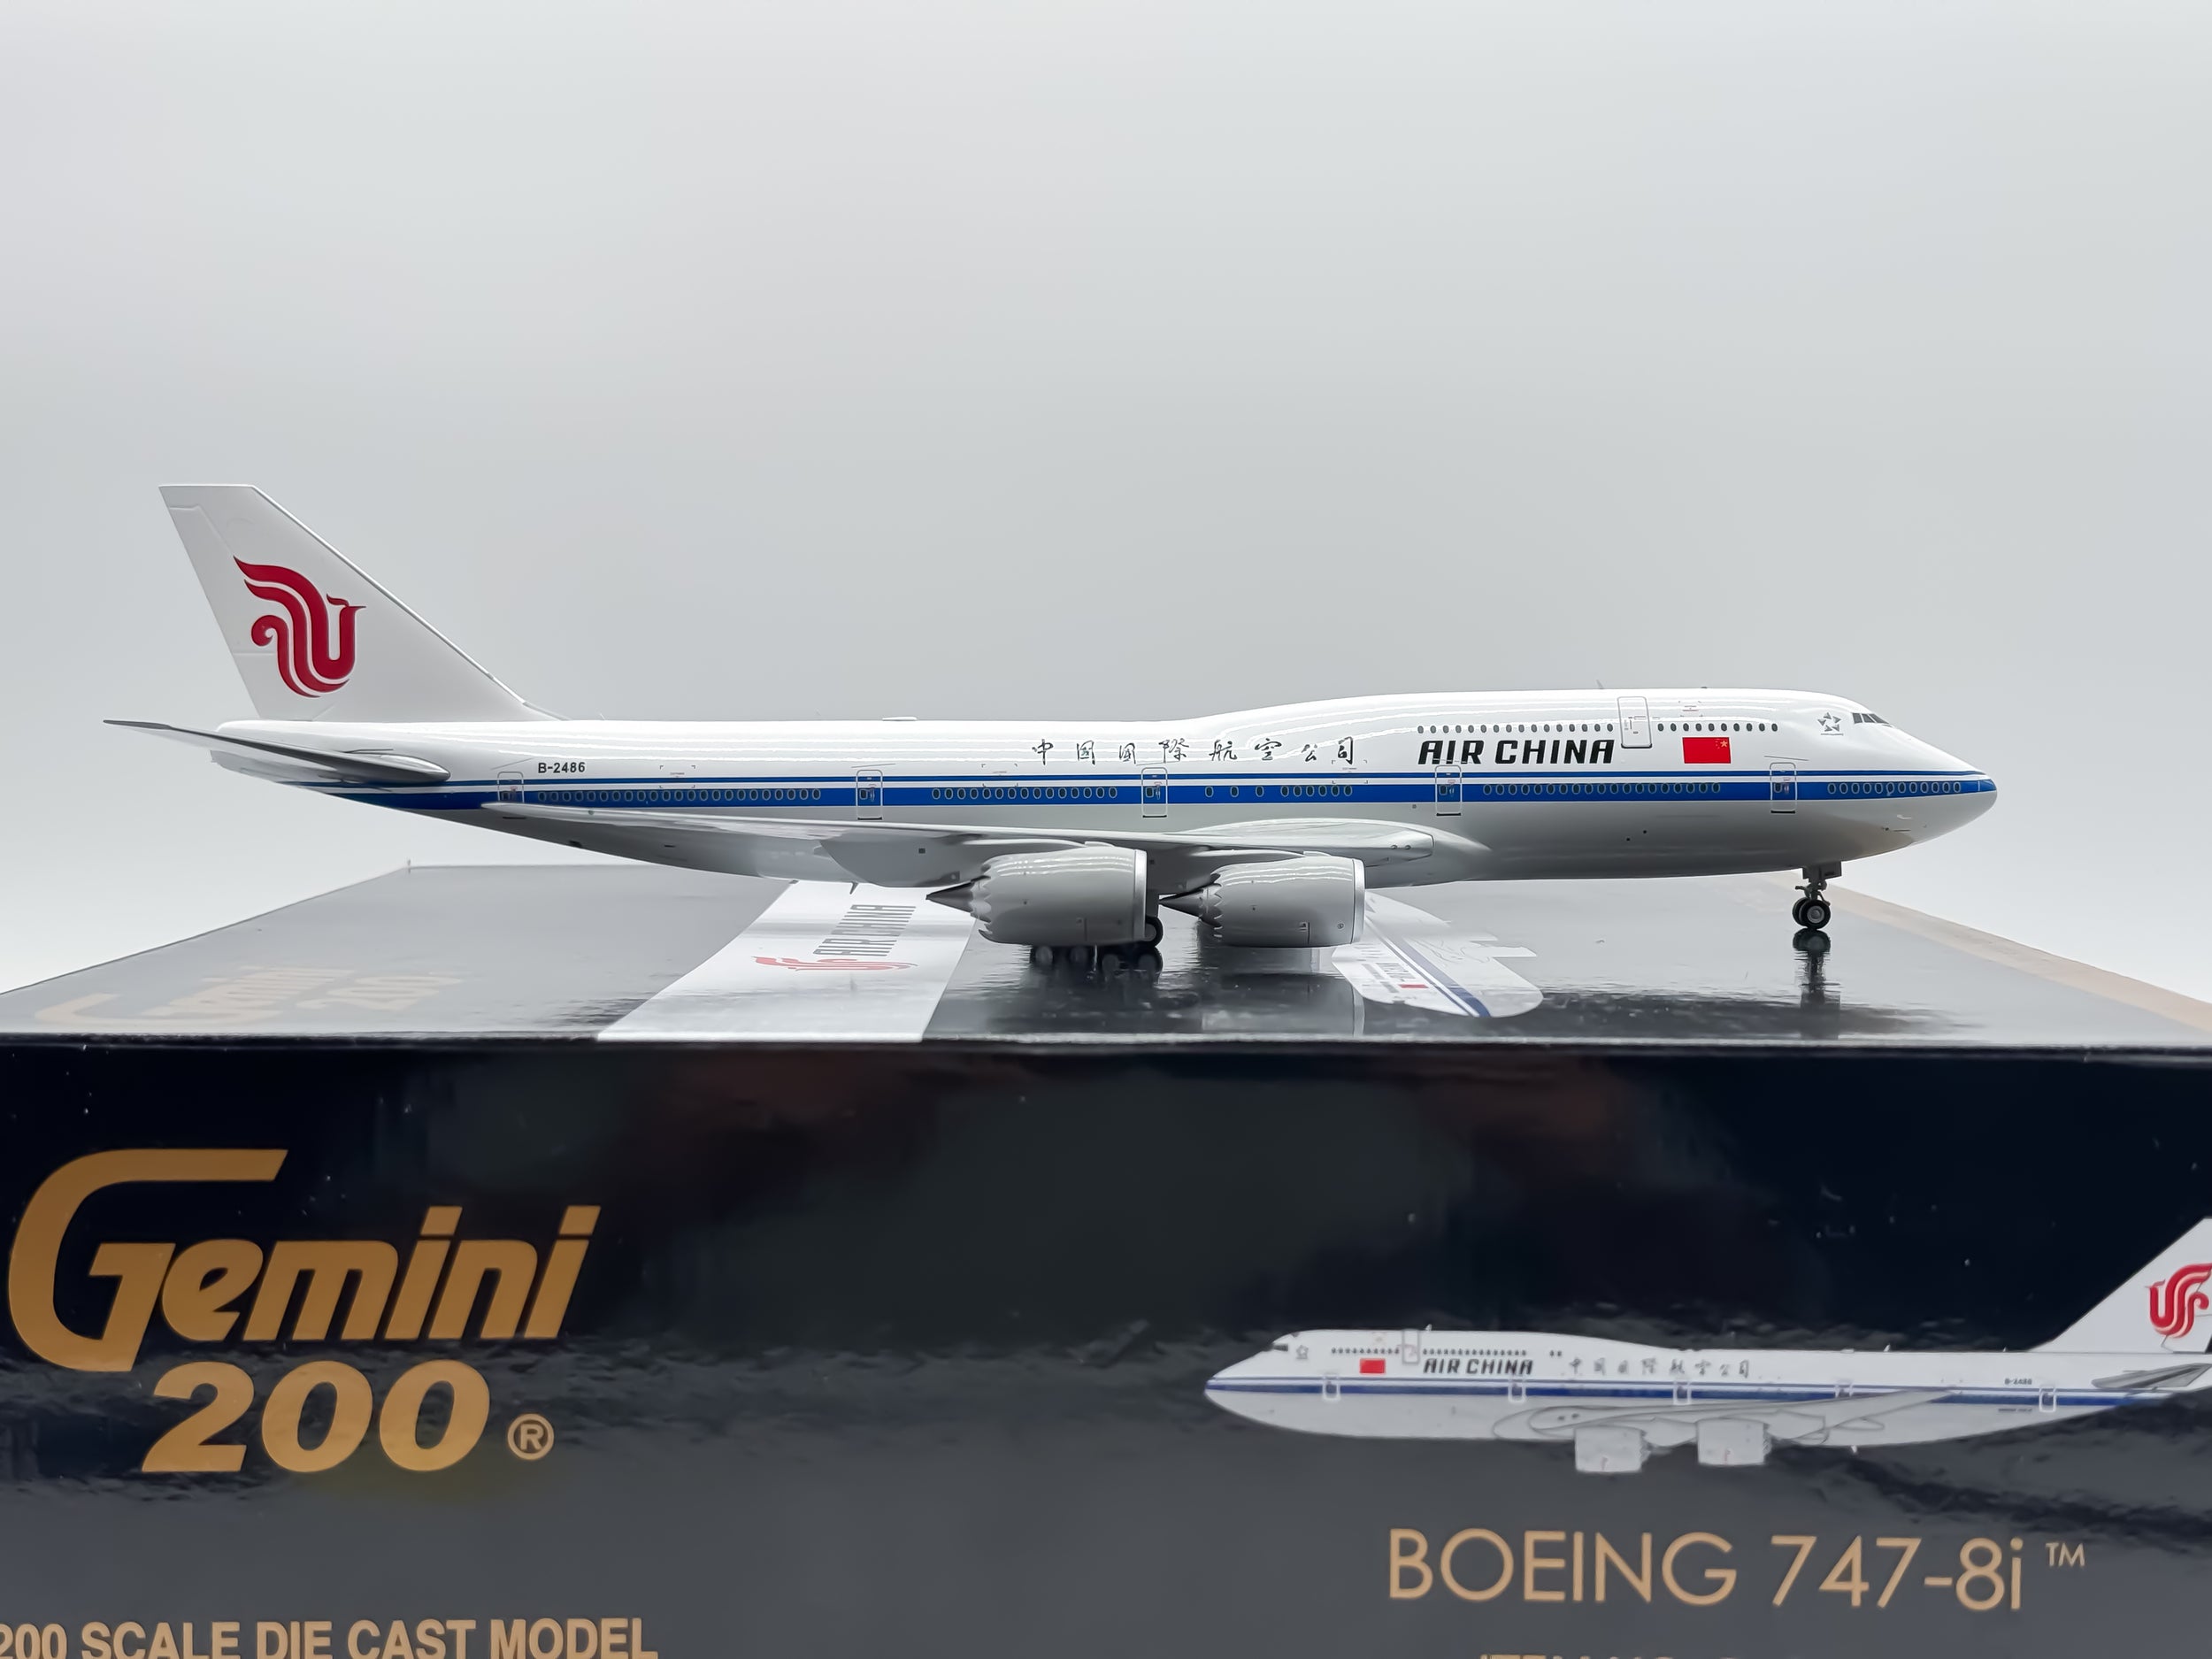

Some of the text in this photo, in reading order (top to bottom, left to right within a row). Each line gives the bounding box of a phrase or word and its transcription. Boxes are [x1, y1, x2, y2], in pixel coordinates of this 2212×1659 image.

[537, 761, 586, 774] B-2486
[1417, 739, 1615, 764] AIR CHINA
[813, 904, 916, 956] AIR CHINA
[7, 1148, 601, 1372] Gemini
[1423, 1357, 1533, 1376] AIR CHINA
[142, 1359, 490, 1473] 200
[1389, 1528, 1737, 1606] BOEING
[1771, 1534, 2024, 1611] 747-8i
[81, 1621, 241, 1659] SCALE
[257, 1620, 333, 1659] DIE
[348, 1618, 477, 1659] CAST
[490, 1617, 659, 1659] MODEL
